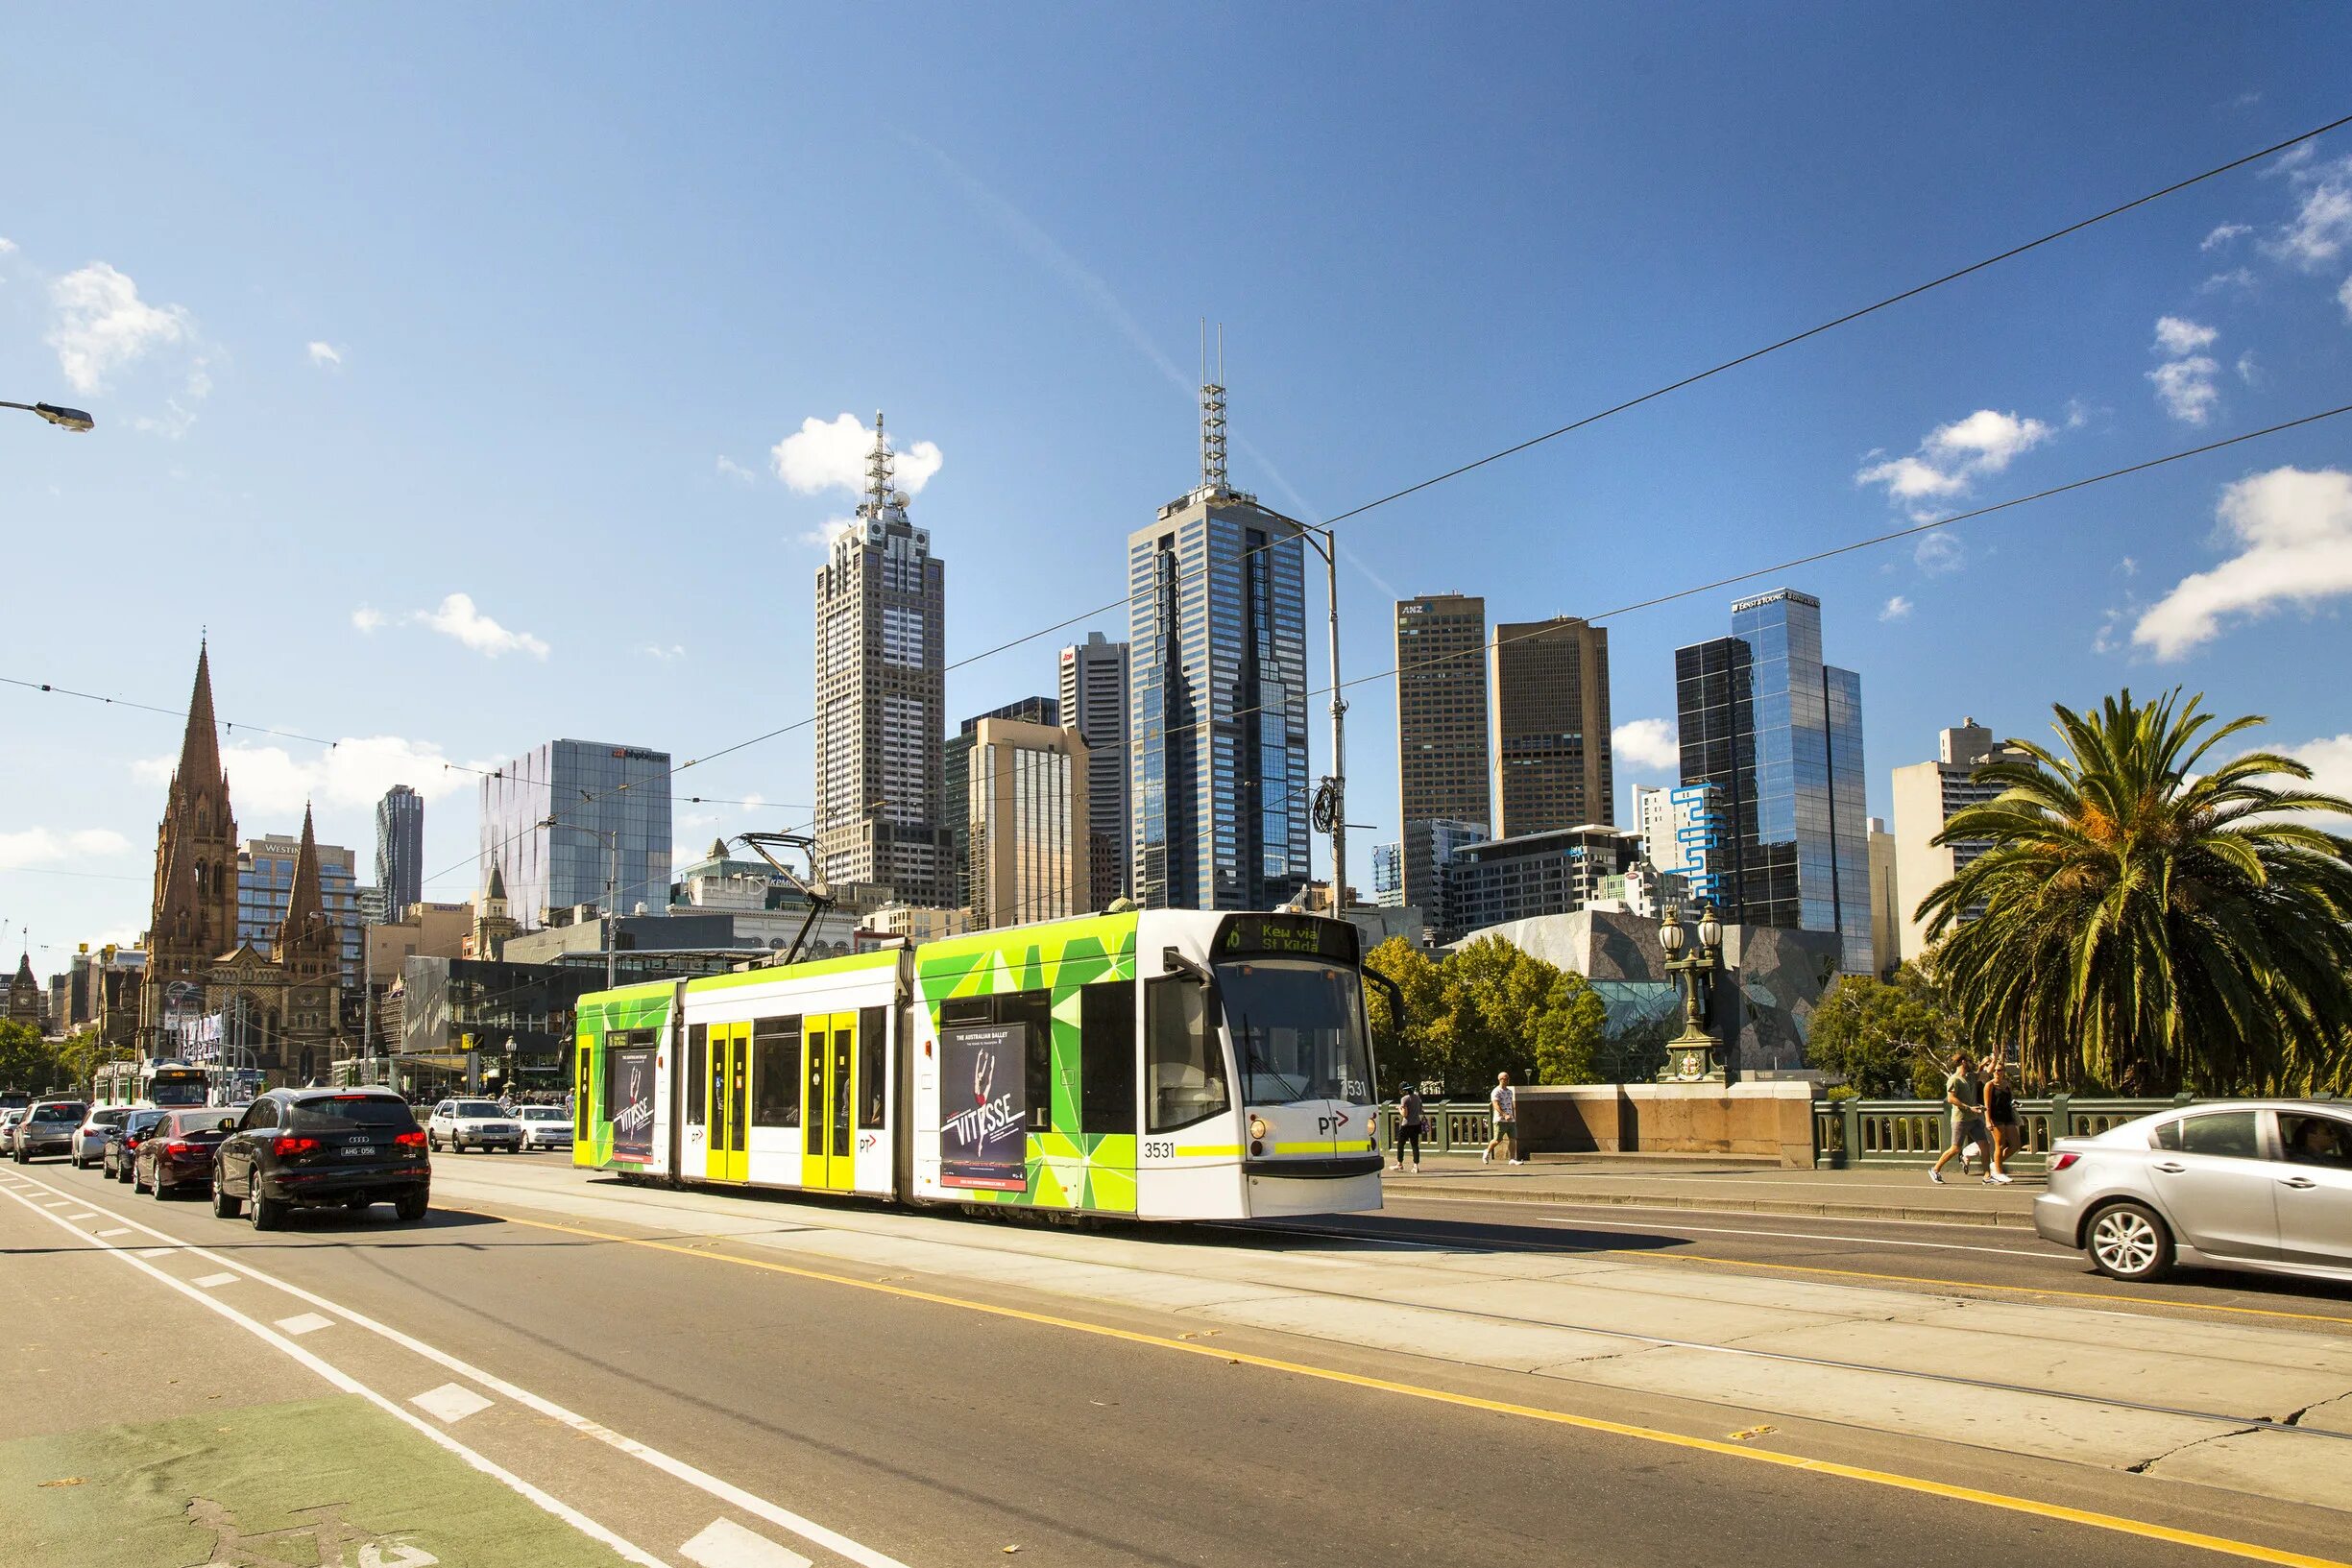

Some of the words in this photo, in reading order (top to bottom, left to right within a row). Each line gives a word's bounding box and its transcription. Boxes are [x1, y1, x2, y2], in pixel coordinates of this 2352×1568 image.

[1402, 605, 1423, 615] ANZ
[770, 879, 794, 887] KPMG
[1262, 924, 1291, 938] Kew
[1297, 928, 1319, 940] via
[1262, 937, 1278, 951] St
[1284, 940, 1320, 953] Kilda
[965, 1032, 991, 1041] AUSTRALIAN
[614, 1097, 653, 1133] VITESSE
[941, 1093, 1025, 1146] VITESSE
[1145, 1143, 1174, 1158] 3531
